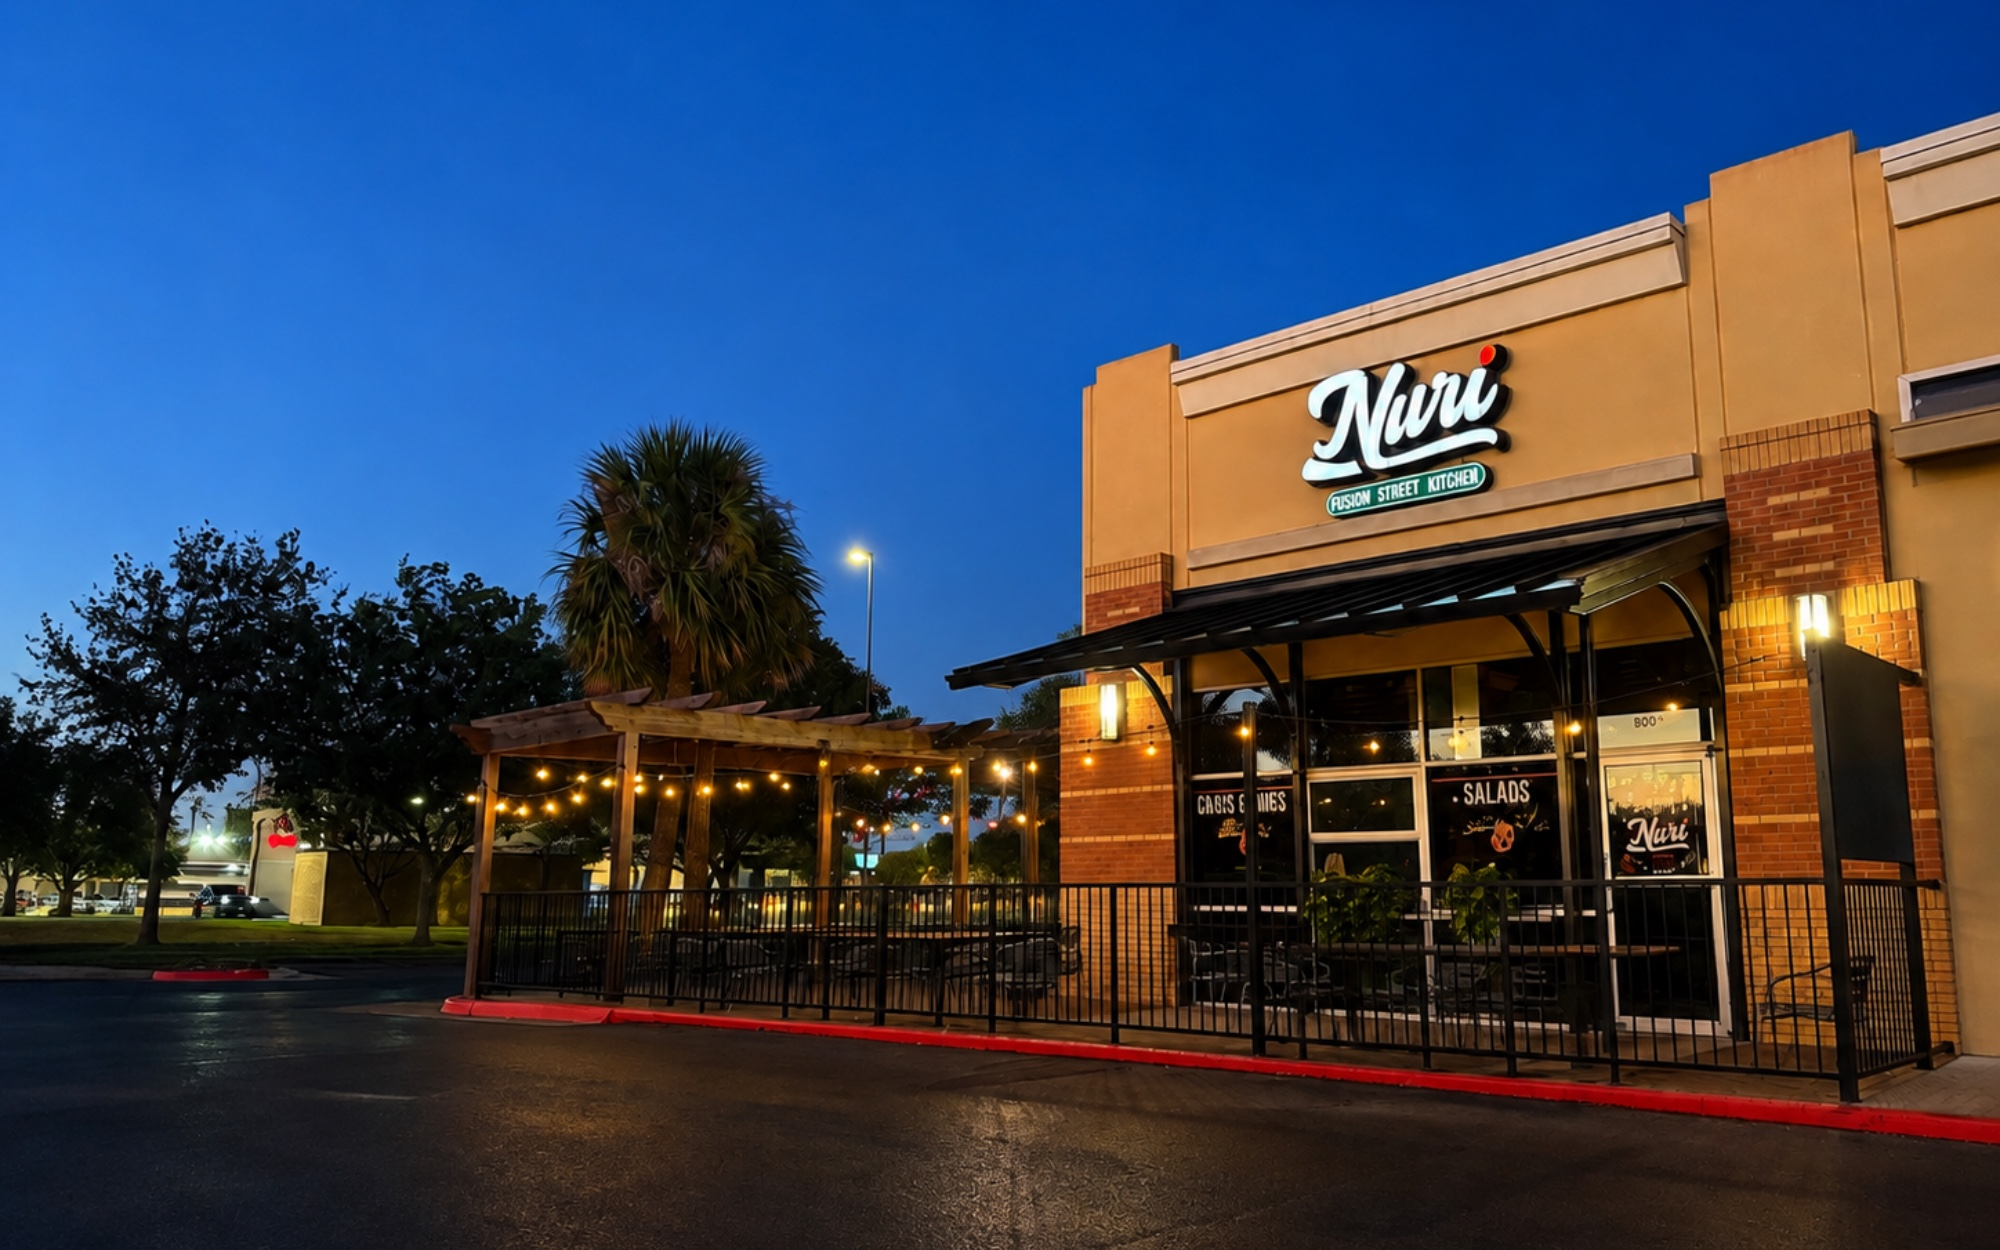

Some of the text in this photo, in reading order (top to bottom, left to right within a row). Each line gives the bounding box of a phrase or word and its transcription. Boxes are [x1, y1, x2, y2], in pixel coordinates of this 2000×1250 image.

[1302, 344, 1499, 481] Nuri
[1331, 467, 1478, 512] FUSION STREET KITCHEN
[1463, 779, 1530, 805] SALADS
[1626, 816, 1690, 852] Nuri
